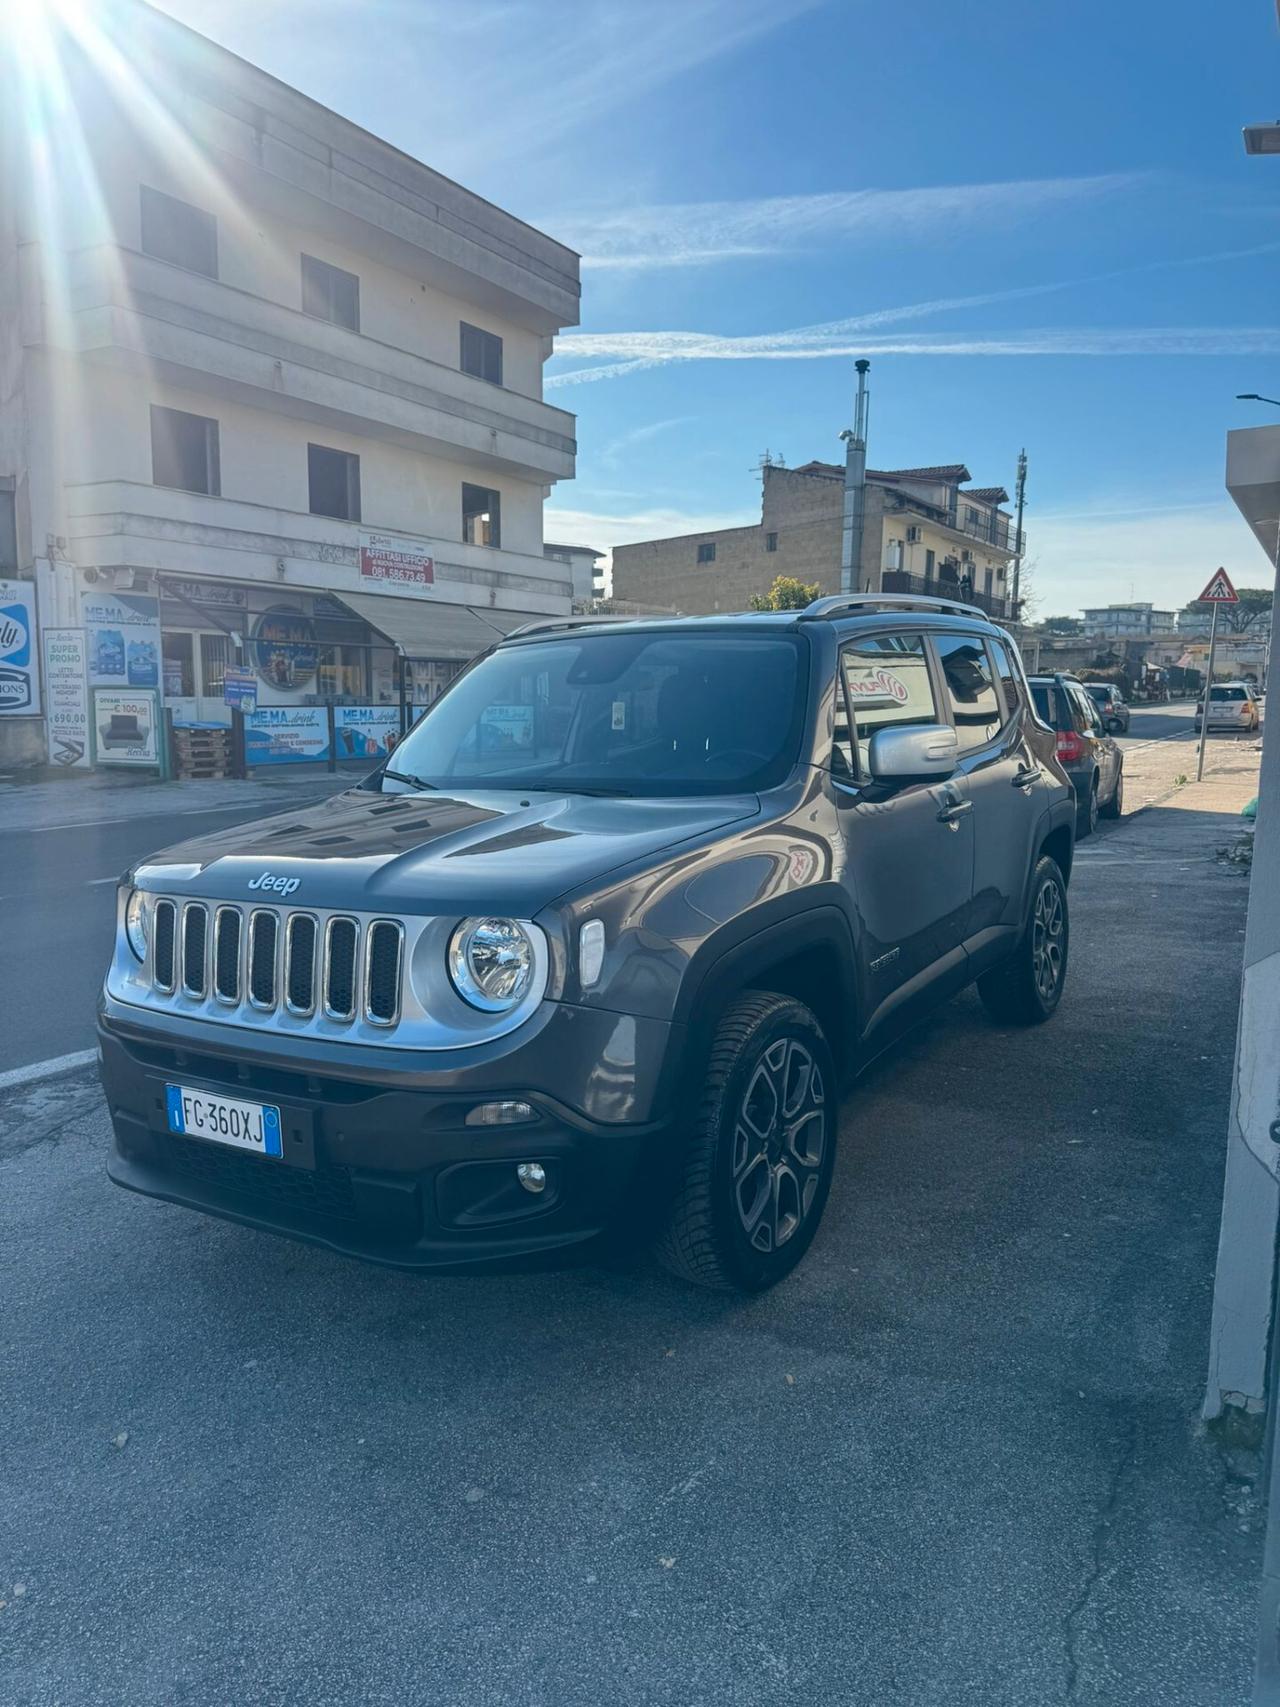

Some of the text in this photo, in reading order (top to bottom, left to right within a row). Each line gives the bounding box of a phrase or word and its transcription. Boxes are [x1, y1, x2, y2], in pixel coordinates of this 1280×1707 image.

[366, 548, 401, 562] AFFITTASI
[402, 553, 429, 567] UFFICIO
[0, 621, 18, 649] ly
[51, 645, 78, 653] SUPER
[50, 654, 81, 663] PROMO
[251, 710, 288, 723] MEMA
[343, 709, 374, 721] MEMA
[248, 872, 300, 897] Jeep
